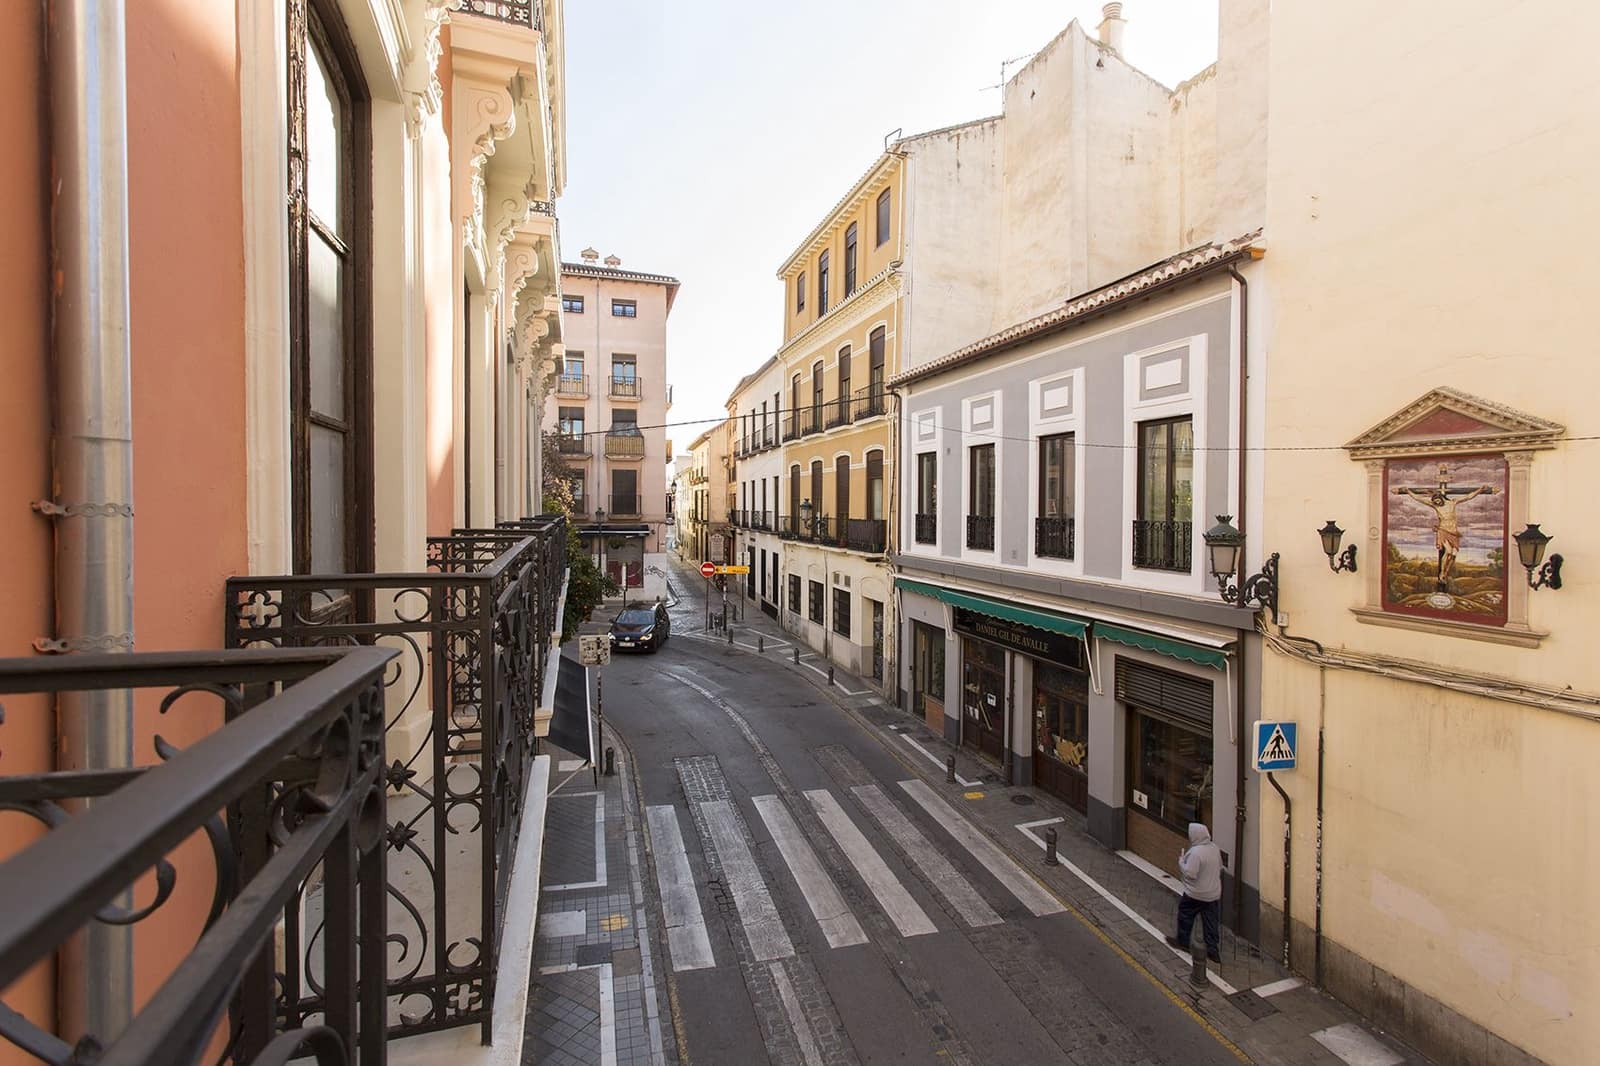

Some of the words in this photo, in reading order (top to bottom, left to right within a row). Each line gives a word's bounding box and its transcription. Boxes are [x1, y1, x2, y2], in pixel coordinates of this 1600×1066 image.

[975, 622, 998, 638] DANIEL
[999, 629, 1010, 641] GIL
[1011, 633, 1021, 645] DE
